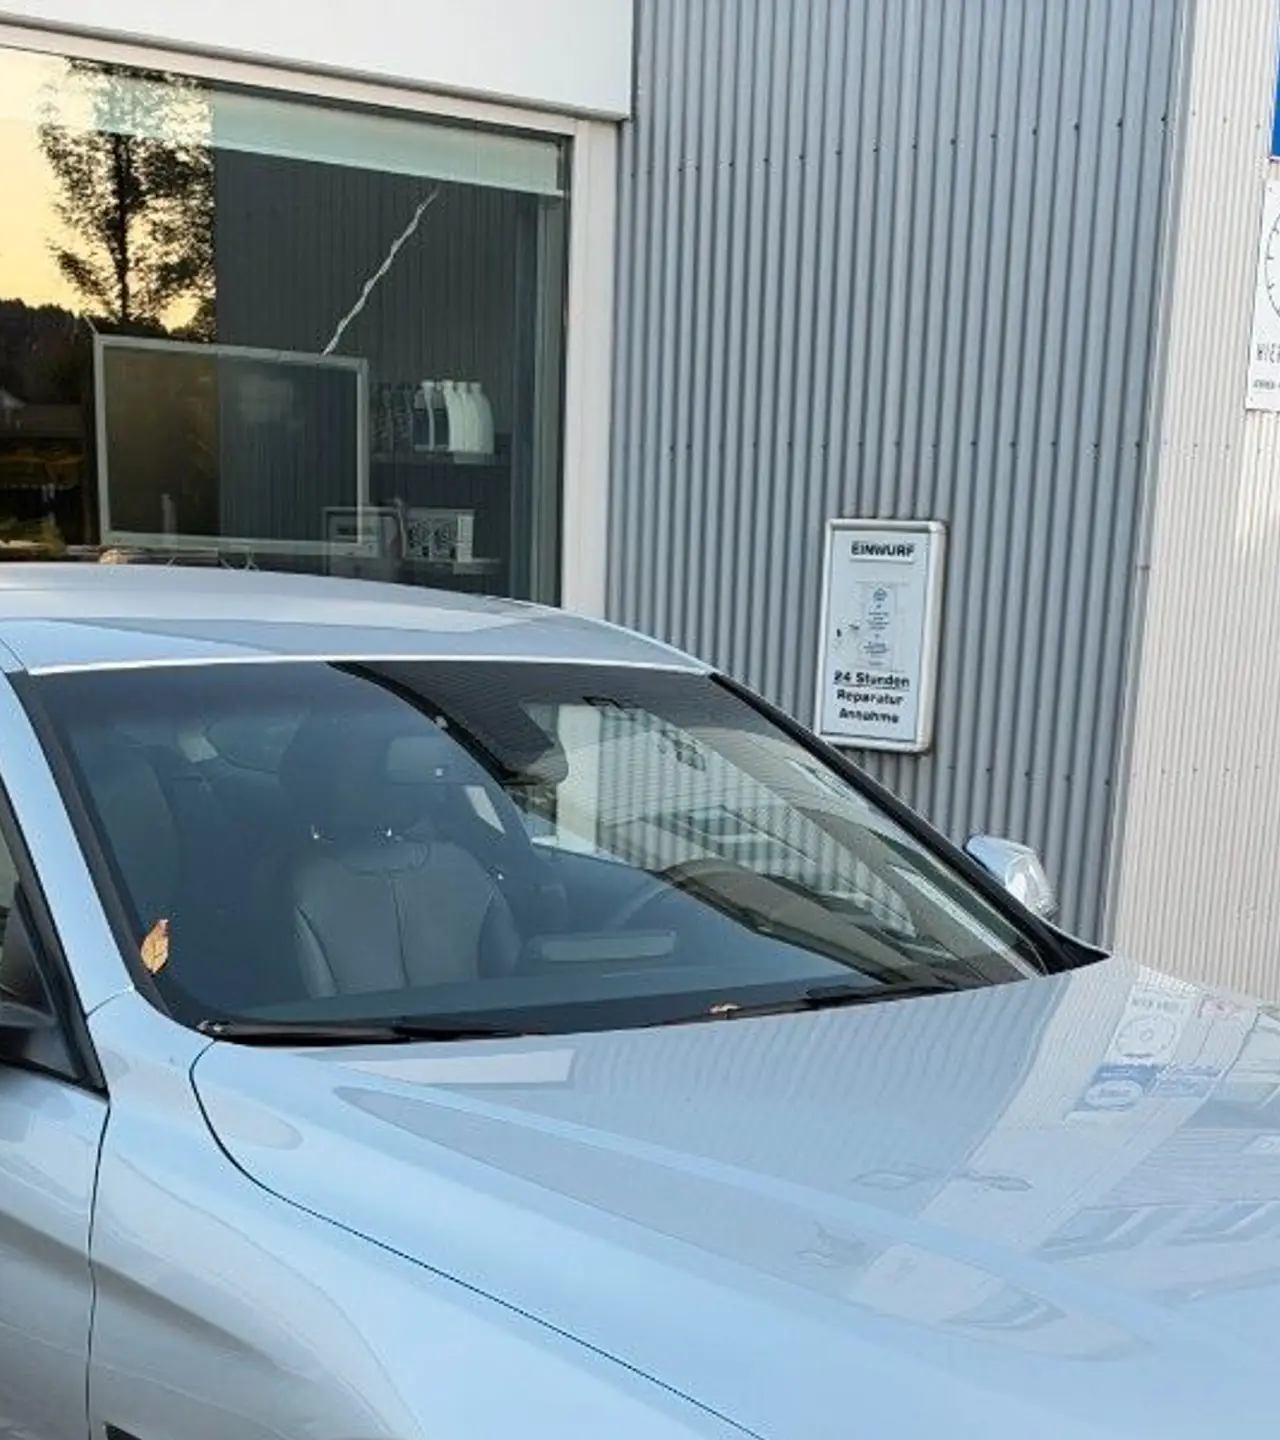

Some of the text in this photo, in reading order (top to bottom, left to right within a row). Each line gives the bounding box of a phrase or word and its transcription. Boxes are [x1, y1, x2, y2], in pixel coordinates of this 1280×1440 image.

[851, 540, 916, 558] EINWURF
[834, 670, 910, 688] 24 Stunden
[836, 688, 904, 705] Reparatur
[839, 707, 899, 724] Annahme
